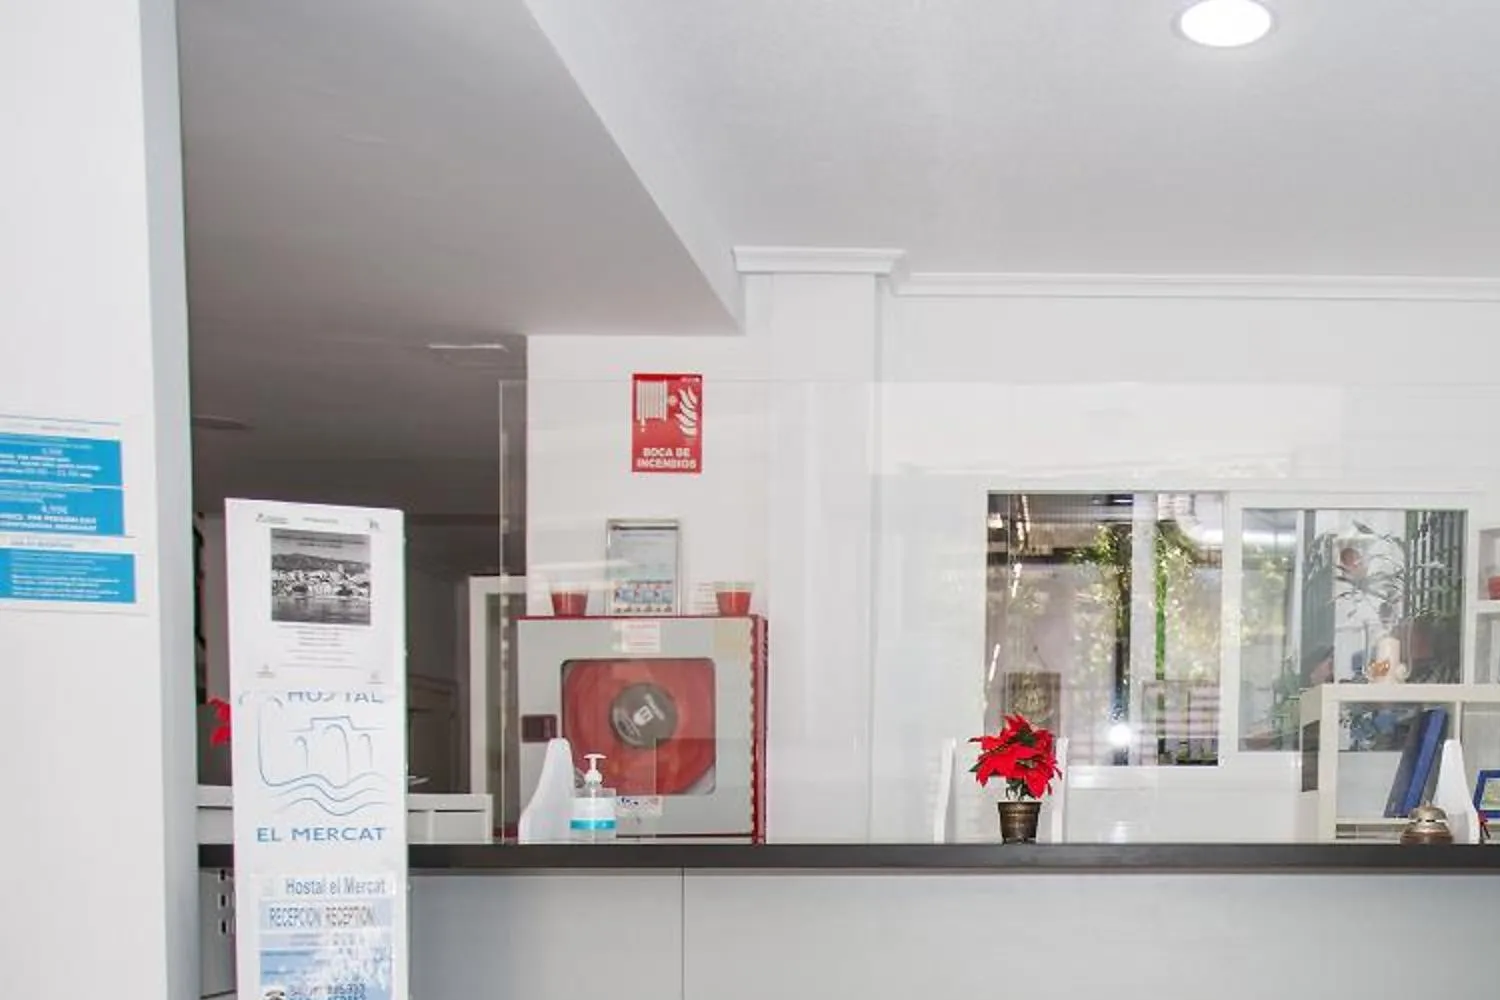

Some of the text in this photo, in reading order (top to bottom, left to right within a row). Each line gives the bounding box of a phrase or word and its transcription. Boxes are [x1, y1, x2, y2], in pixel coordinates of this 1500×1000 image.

[643, 447, 690, 457] BOCA DE
[257, 827, 386, 842] EL MERCAT
